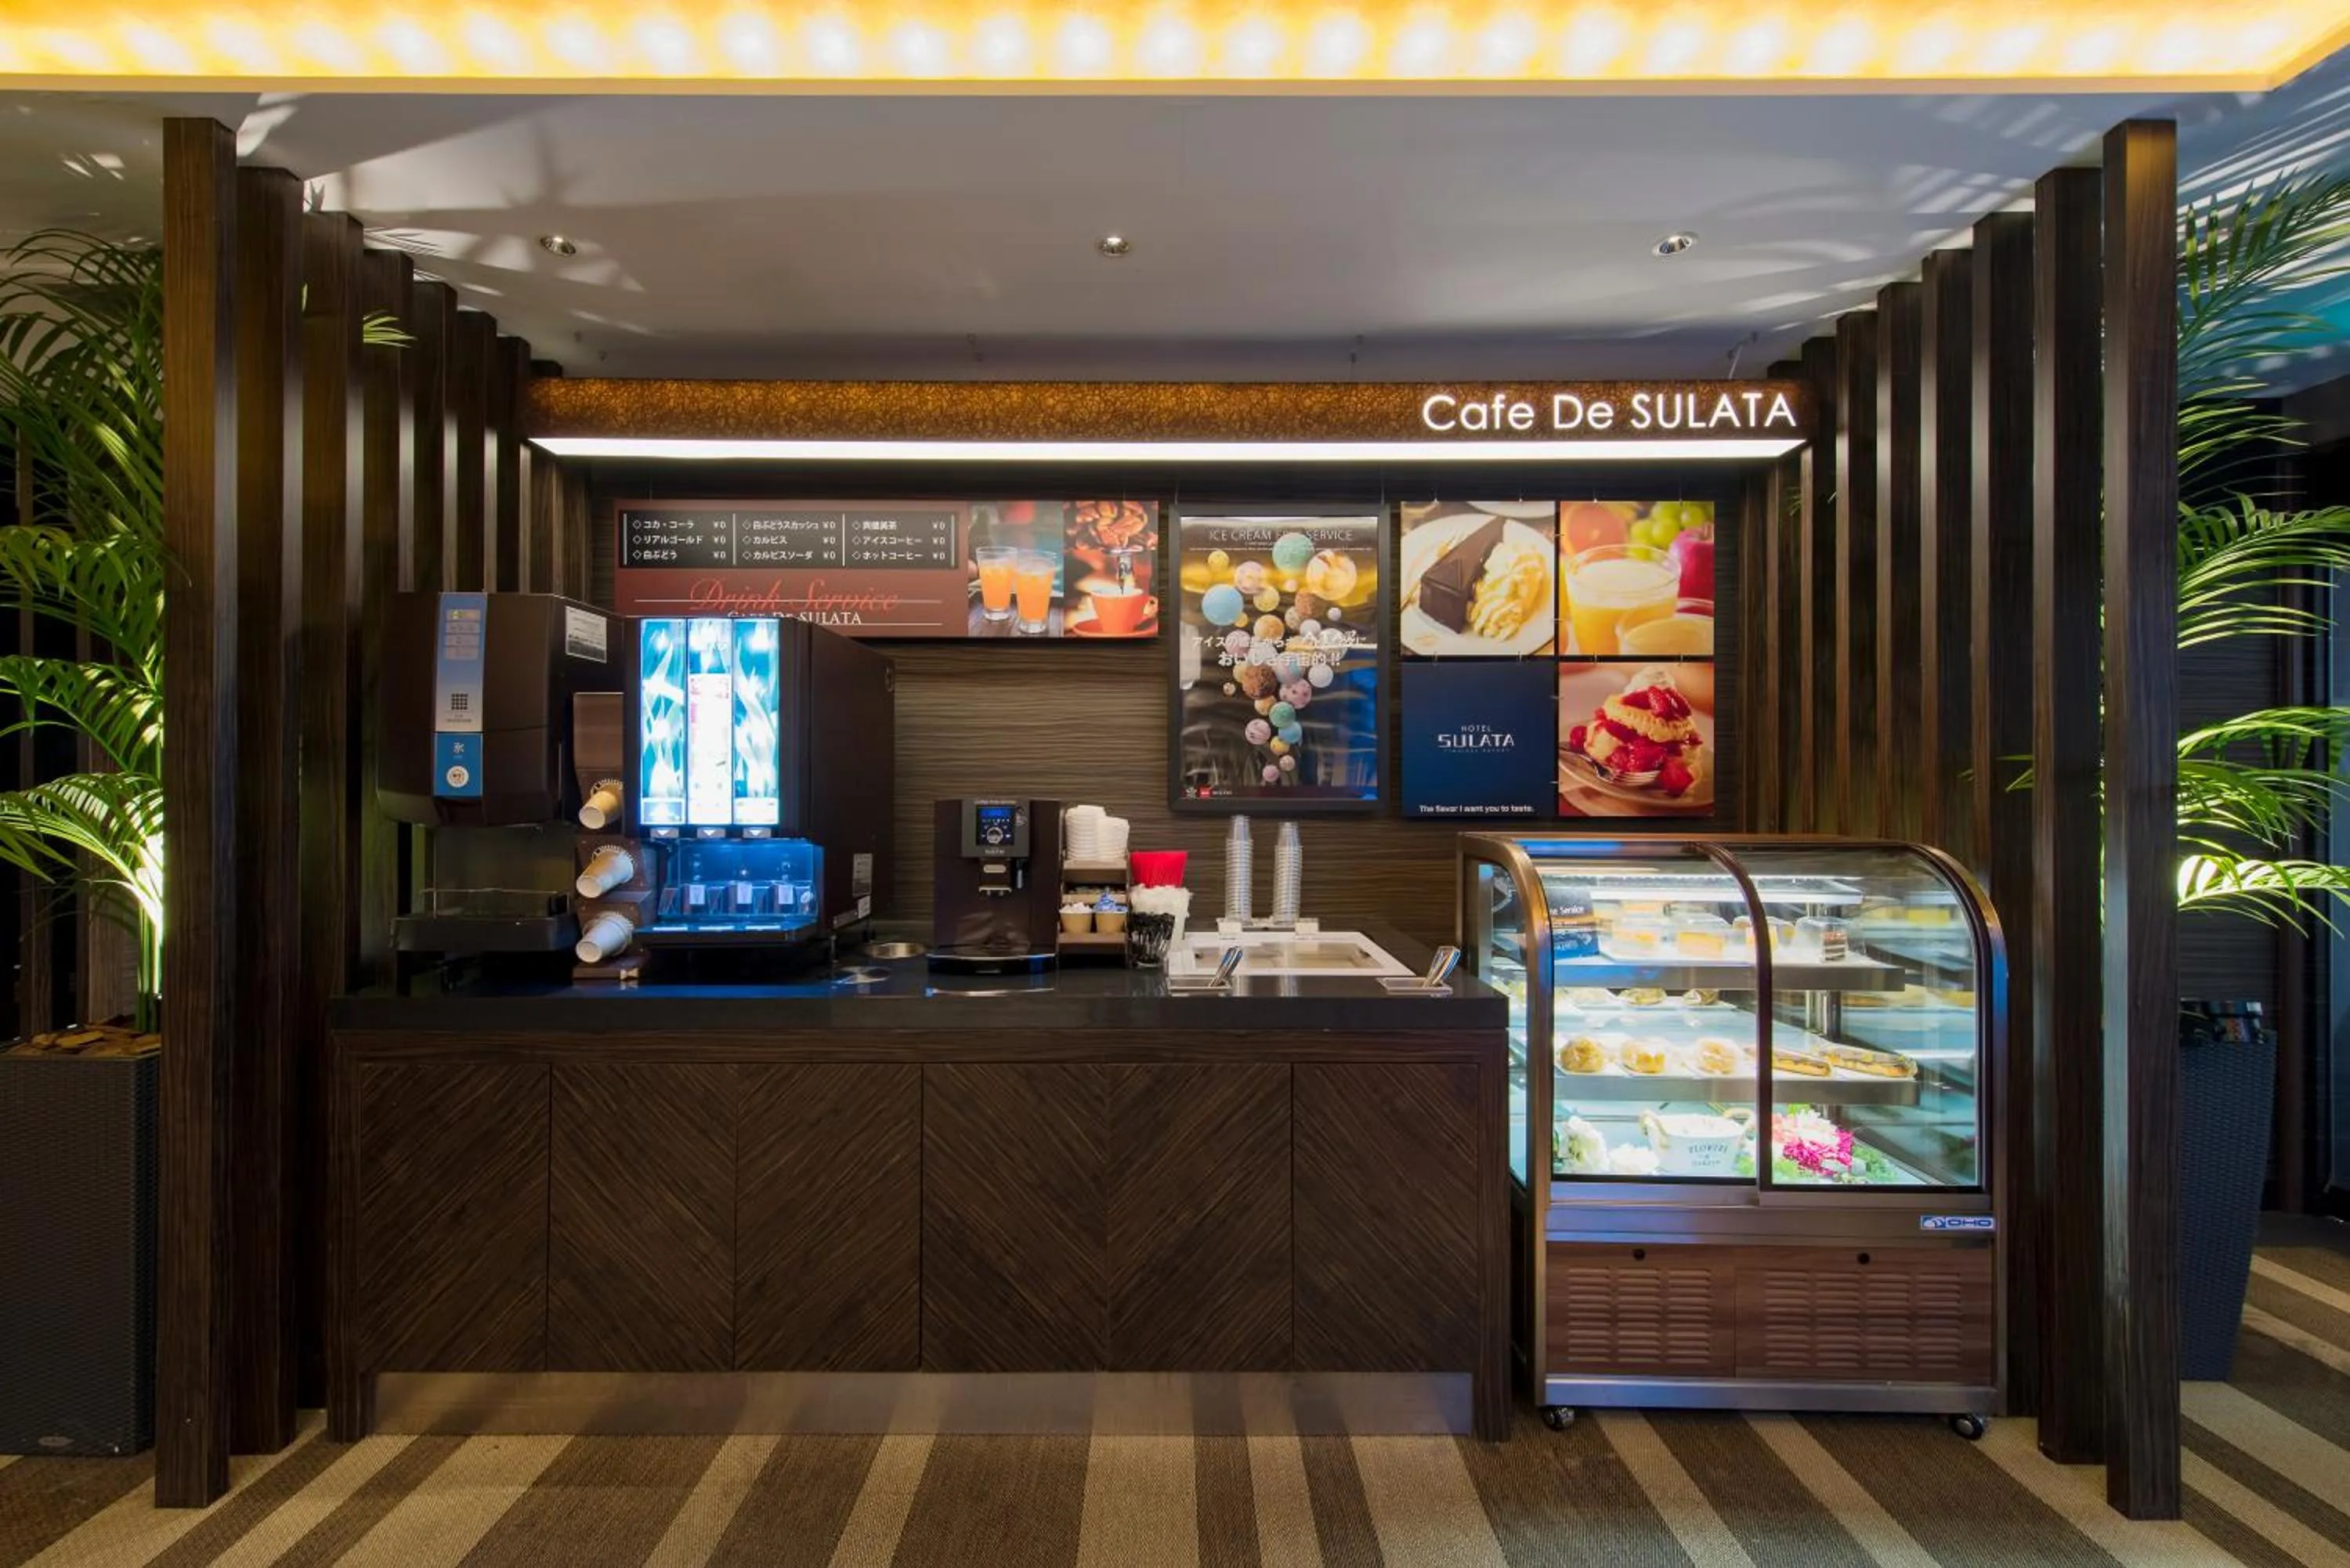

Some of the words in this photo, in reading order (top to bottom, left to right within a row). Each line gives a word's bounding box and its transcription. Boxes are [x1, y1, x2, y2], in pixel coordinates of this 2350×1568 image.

[1422, 394, 1535, 431] Cafe
[1553, 395, 1614, 430] De
[1629, 392, 1797, 429] SULATA
[643, 520, 696, 529] コカ・コーラ
[1209, 529, 1227, 541] ICE
[1231, 527, 1272, 541] CREAM
[1305, 528, 1354, 541] SERVICE
[643, 535, 704, 545] リアルゴールド
[753, 536, 788, 544] カルピス
[862, 536, 924, 545] アイスコーヒー
[643, 550, 678, 560] 白ぶどう
[753, 551, 813, 560] カルピスソーダ
[862, 551, 924, 561] ホットコーヒー
[689, 577, 783, 611] Drink
[791, 578, 900, 611] Service
[799, 612, 862, 625] SULATA
[1437, 734, 1515, 748] SULATA
[1485, 806, 1499, 815] you
